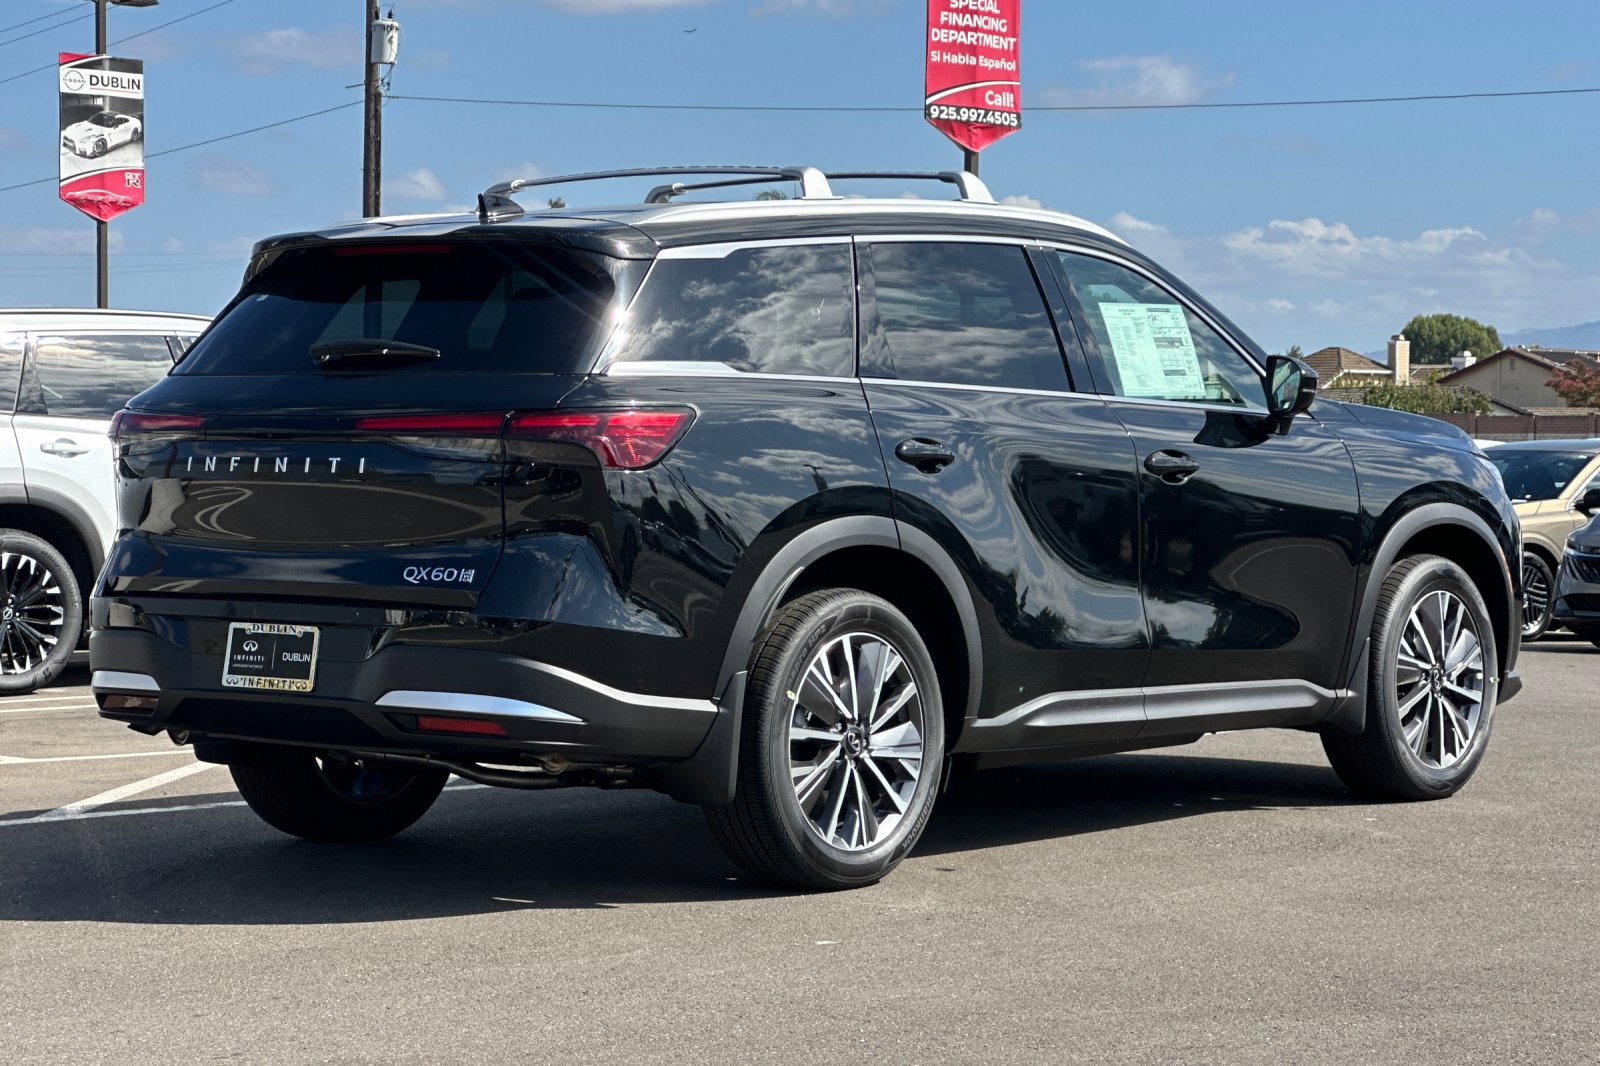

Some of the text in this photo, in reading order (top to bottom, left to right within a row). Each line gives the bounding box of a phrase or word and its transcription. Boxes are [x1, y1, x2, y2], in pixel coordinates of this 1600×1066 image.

[949, 0, 1001, 14] SPECIAL
[940, 11, 1007, 32] FINANCING
[931, 28, 1016, 51] DEPARTMENT
[930, 50, 1016, 71] Si Habla Español
[89, 74, 141, 91] DUBLIN
[984, 90, 1015, 108] Call!
[929, 105, 1018, 126] 925.997.4505
[186, 456, 366, 474] INFINITI
[402, 566, 459, 584] QX60
[252, 623, 297, 634] DUBLIN
[233, 654, 265, 662] INFINITI
[282, 652, 311, 663] DUBLIN
